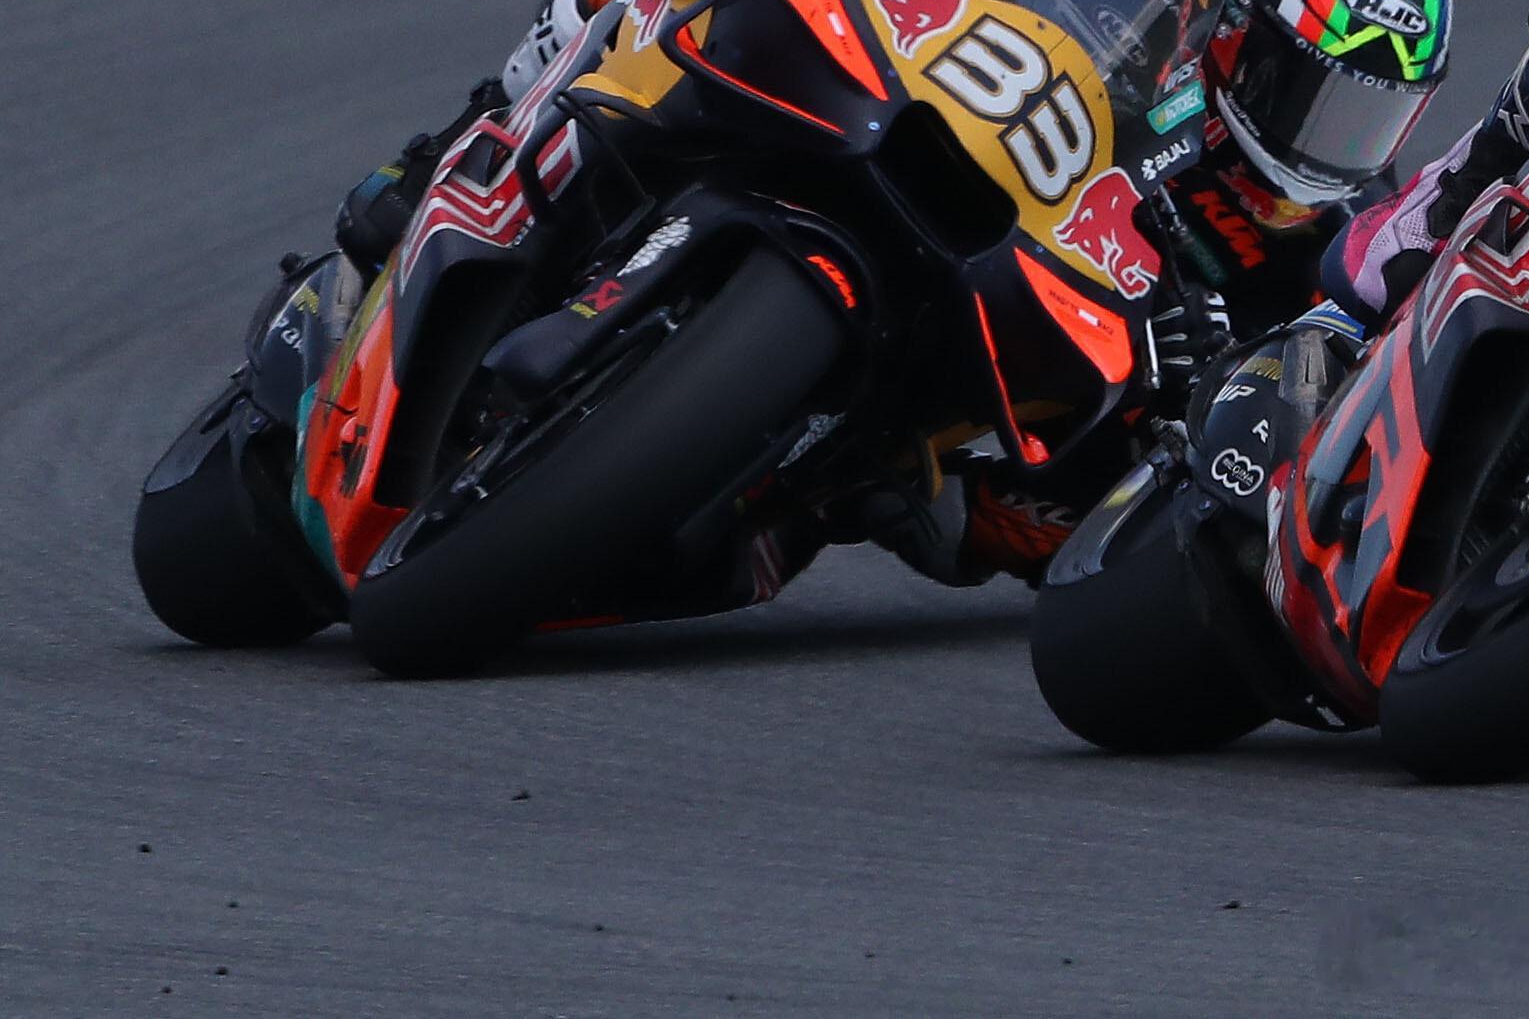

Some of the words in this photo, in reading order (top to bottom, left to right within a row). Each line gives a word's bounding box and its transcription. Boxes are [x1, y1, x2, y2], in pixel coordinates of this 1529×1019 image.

[1352, 68, 1388, 90] YOU
[922, 13, 1096, 206] 33
[1154, 137, 1191, 171] BAJAJ
